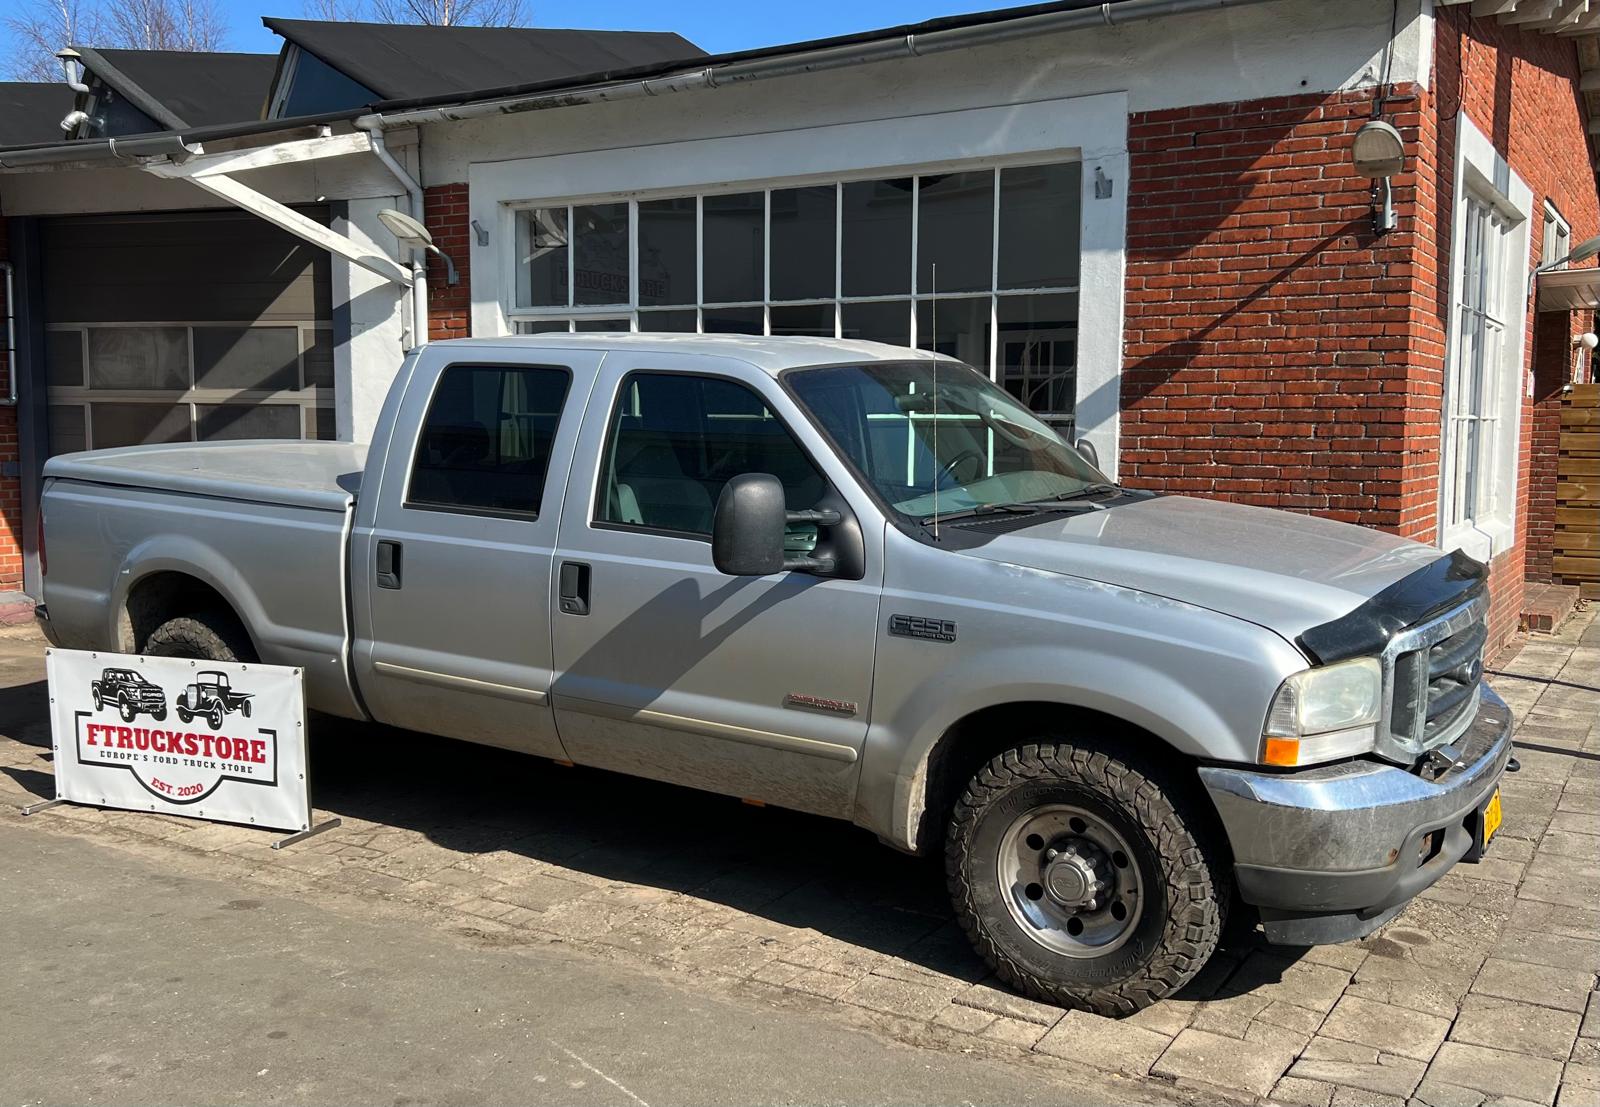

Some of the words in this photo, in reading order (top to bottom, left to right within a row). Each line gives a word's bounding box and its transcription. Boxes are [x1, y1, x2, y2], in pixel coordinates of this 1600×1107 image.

[87, 723, 266, 763] FTRUCKSTORE
[100, 751, 148, 761] EUROPE'S
[153, 755, 178, 764] FORD
[183, 759, 216, 769] TRUCK
[221, 763, 253, 773] STORE
[151, 777, 175, 795] EST.
[177, 783, 203, 796] 2020
